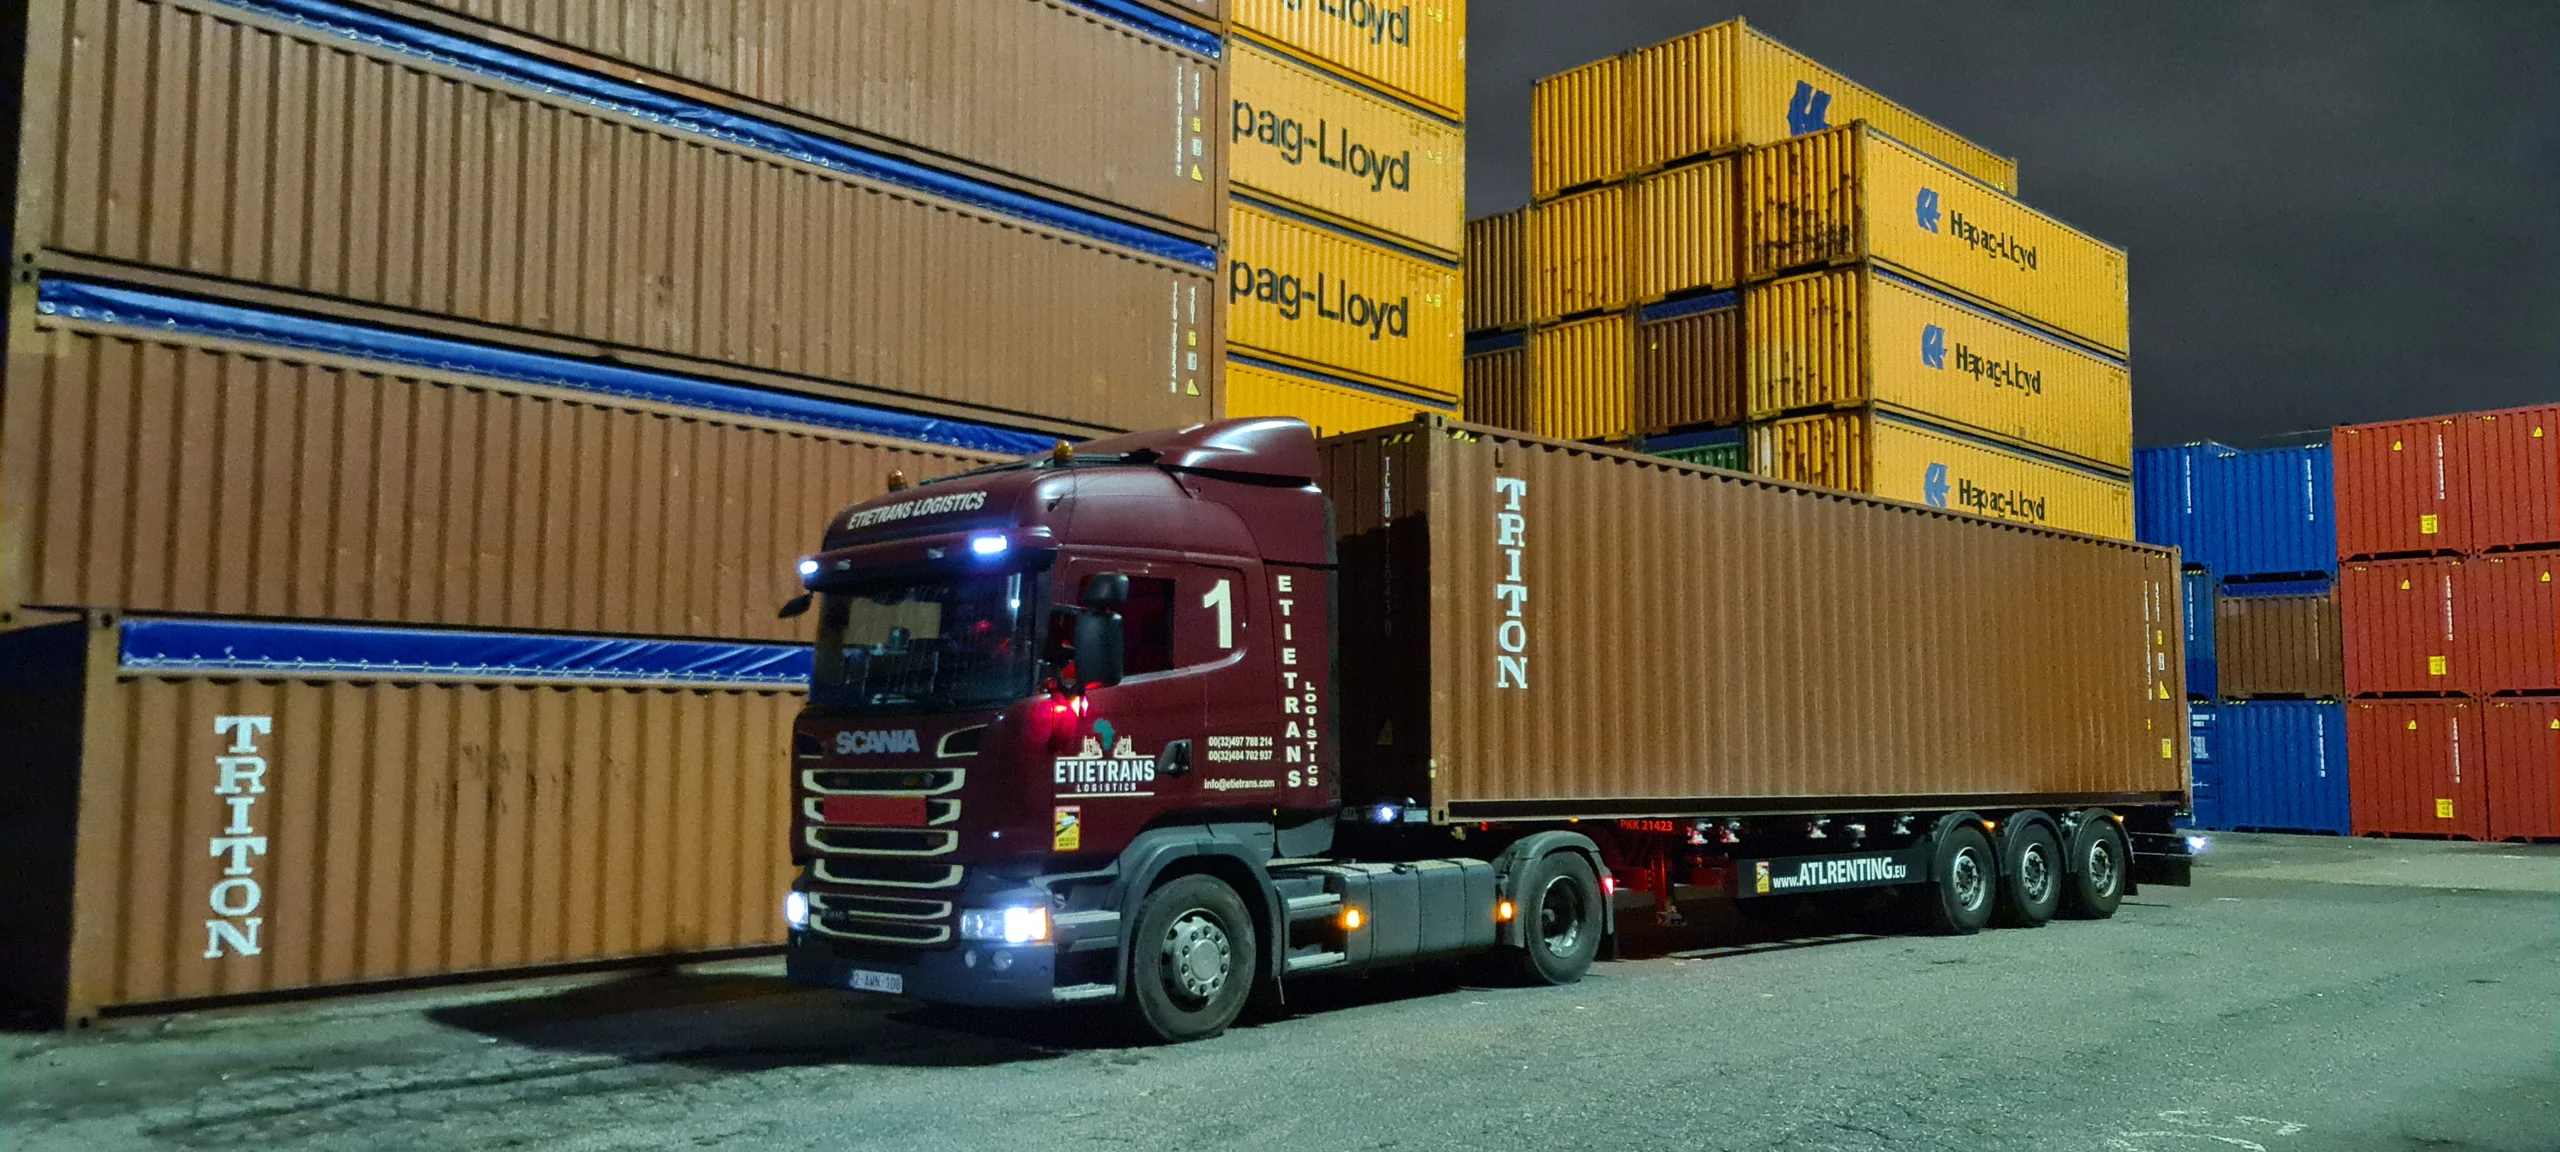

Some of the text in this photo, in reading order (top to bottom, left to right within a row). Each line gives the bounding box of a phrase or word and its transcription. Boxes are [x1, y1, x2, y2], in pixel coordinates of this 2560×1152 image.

[1950, 210, 2037, 271] Hapag-Lloyd
[1956, 343, 2041, 397] Hapag-Lloyd
[847, 491, 987, 530] ETIETRANS LOGISTICS
[1958, 478, 2045, 525] Hapag-Lloyd
[1495, 476, 1528, 689] TRITON
[1203, 579, 1233, 649] 1
[1277, 575, 1302, 788] ETIETRANS
[836, 729, 921, 755] SCANIA
[1260, 736, 1273, 747] 214
[1304, 681, 1319, 787] LOGISTICS
[1055, 760, 1155, 783] ETIETRANS
[1076, 782, 1137, 793] LOGISTICS
[1204, 779, 1275, 791] info@etietrans.com
[202, 715, 273, 960] TRITON
[1641, 820, 1673, 831] 21423
